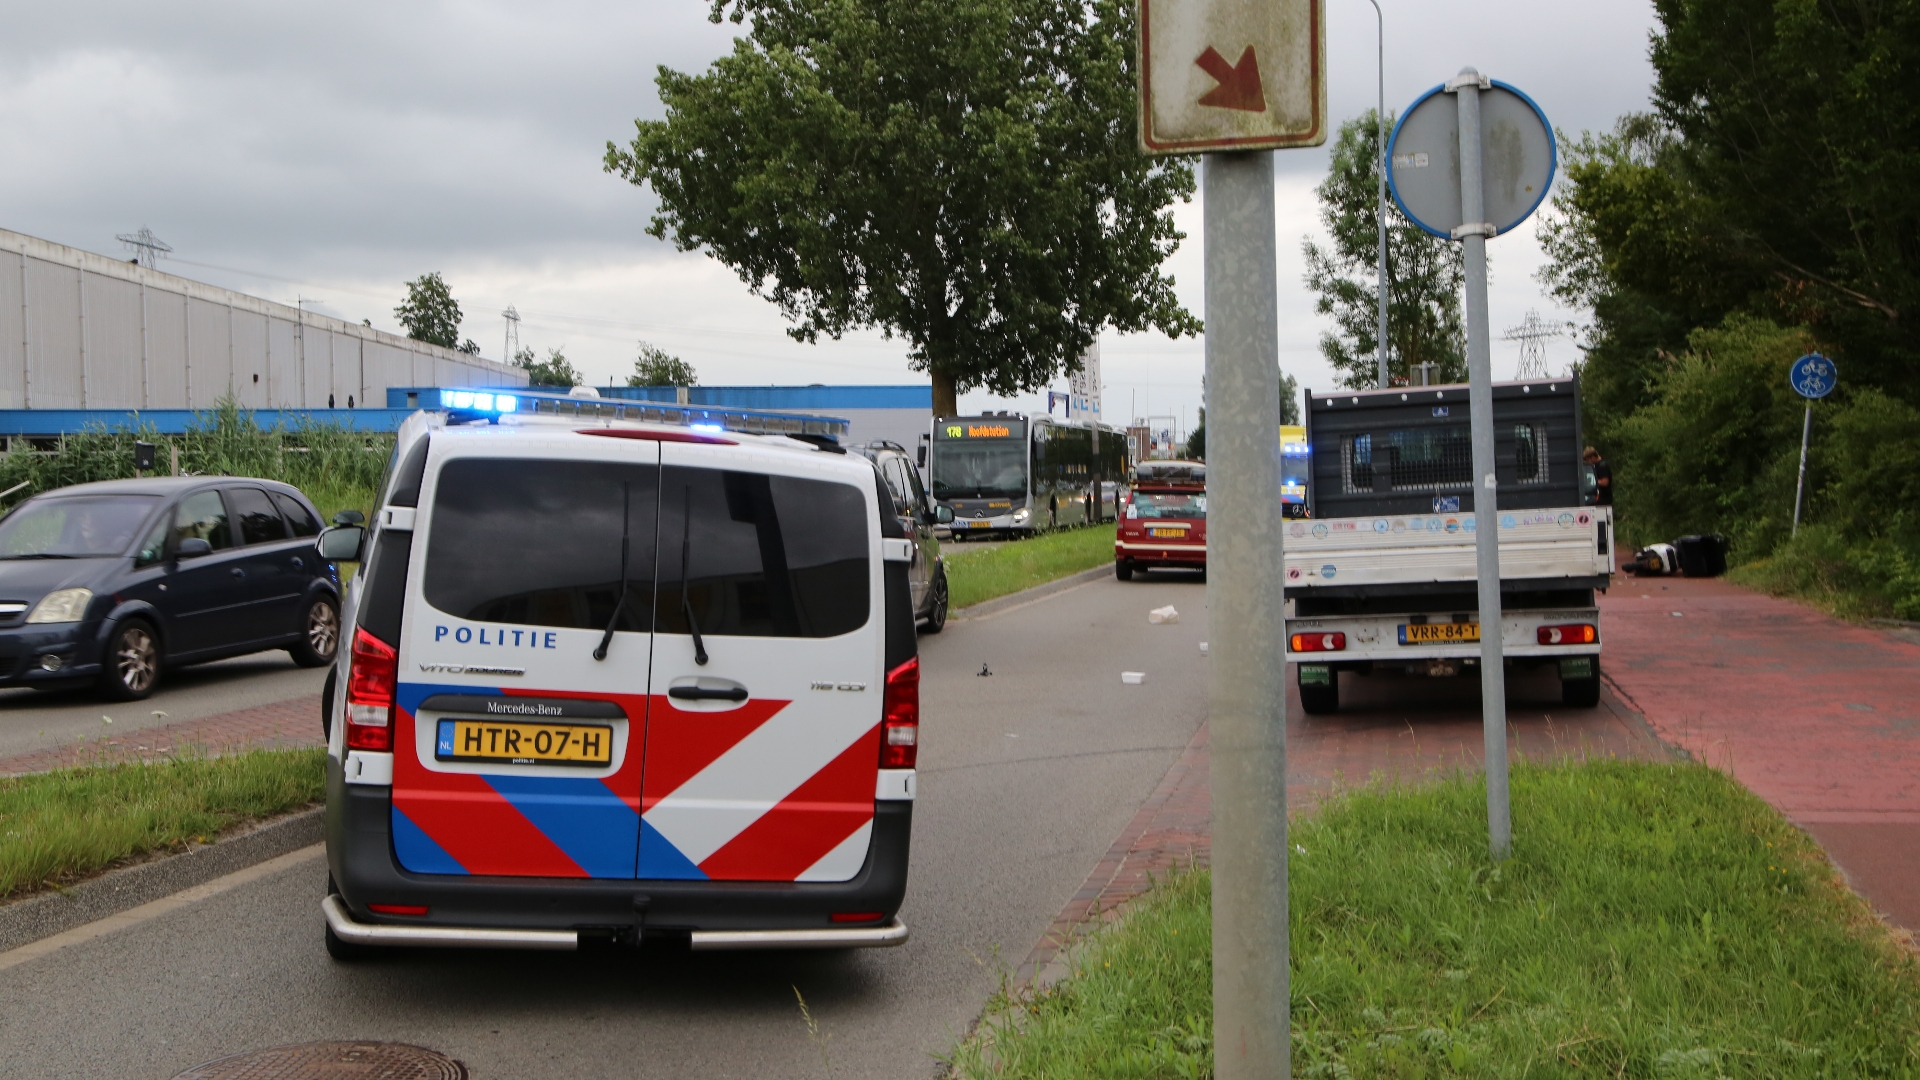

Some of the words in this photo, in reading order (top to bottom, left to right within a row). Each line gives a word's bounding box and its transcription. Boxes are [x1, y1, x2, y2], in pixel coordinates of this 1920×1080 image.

[968, 424, 1010, 438] Hoofdstation
[434, 625, 558, 649] POLITIE
[419, 662, 464, 673] VITO
[487, 701, 563, 716] Mercedes-Benz
[440, 740, 452, 751] NL
[464, 726, 601, 758] HTR-07-H
[512, 757, 535, 765] politie.nl
